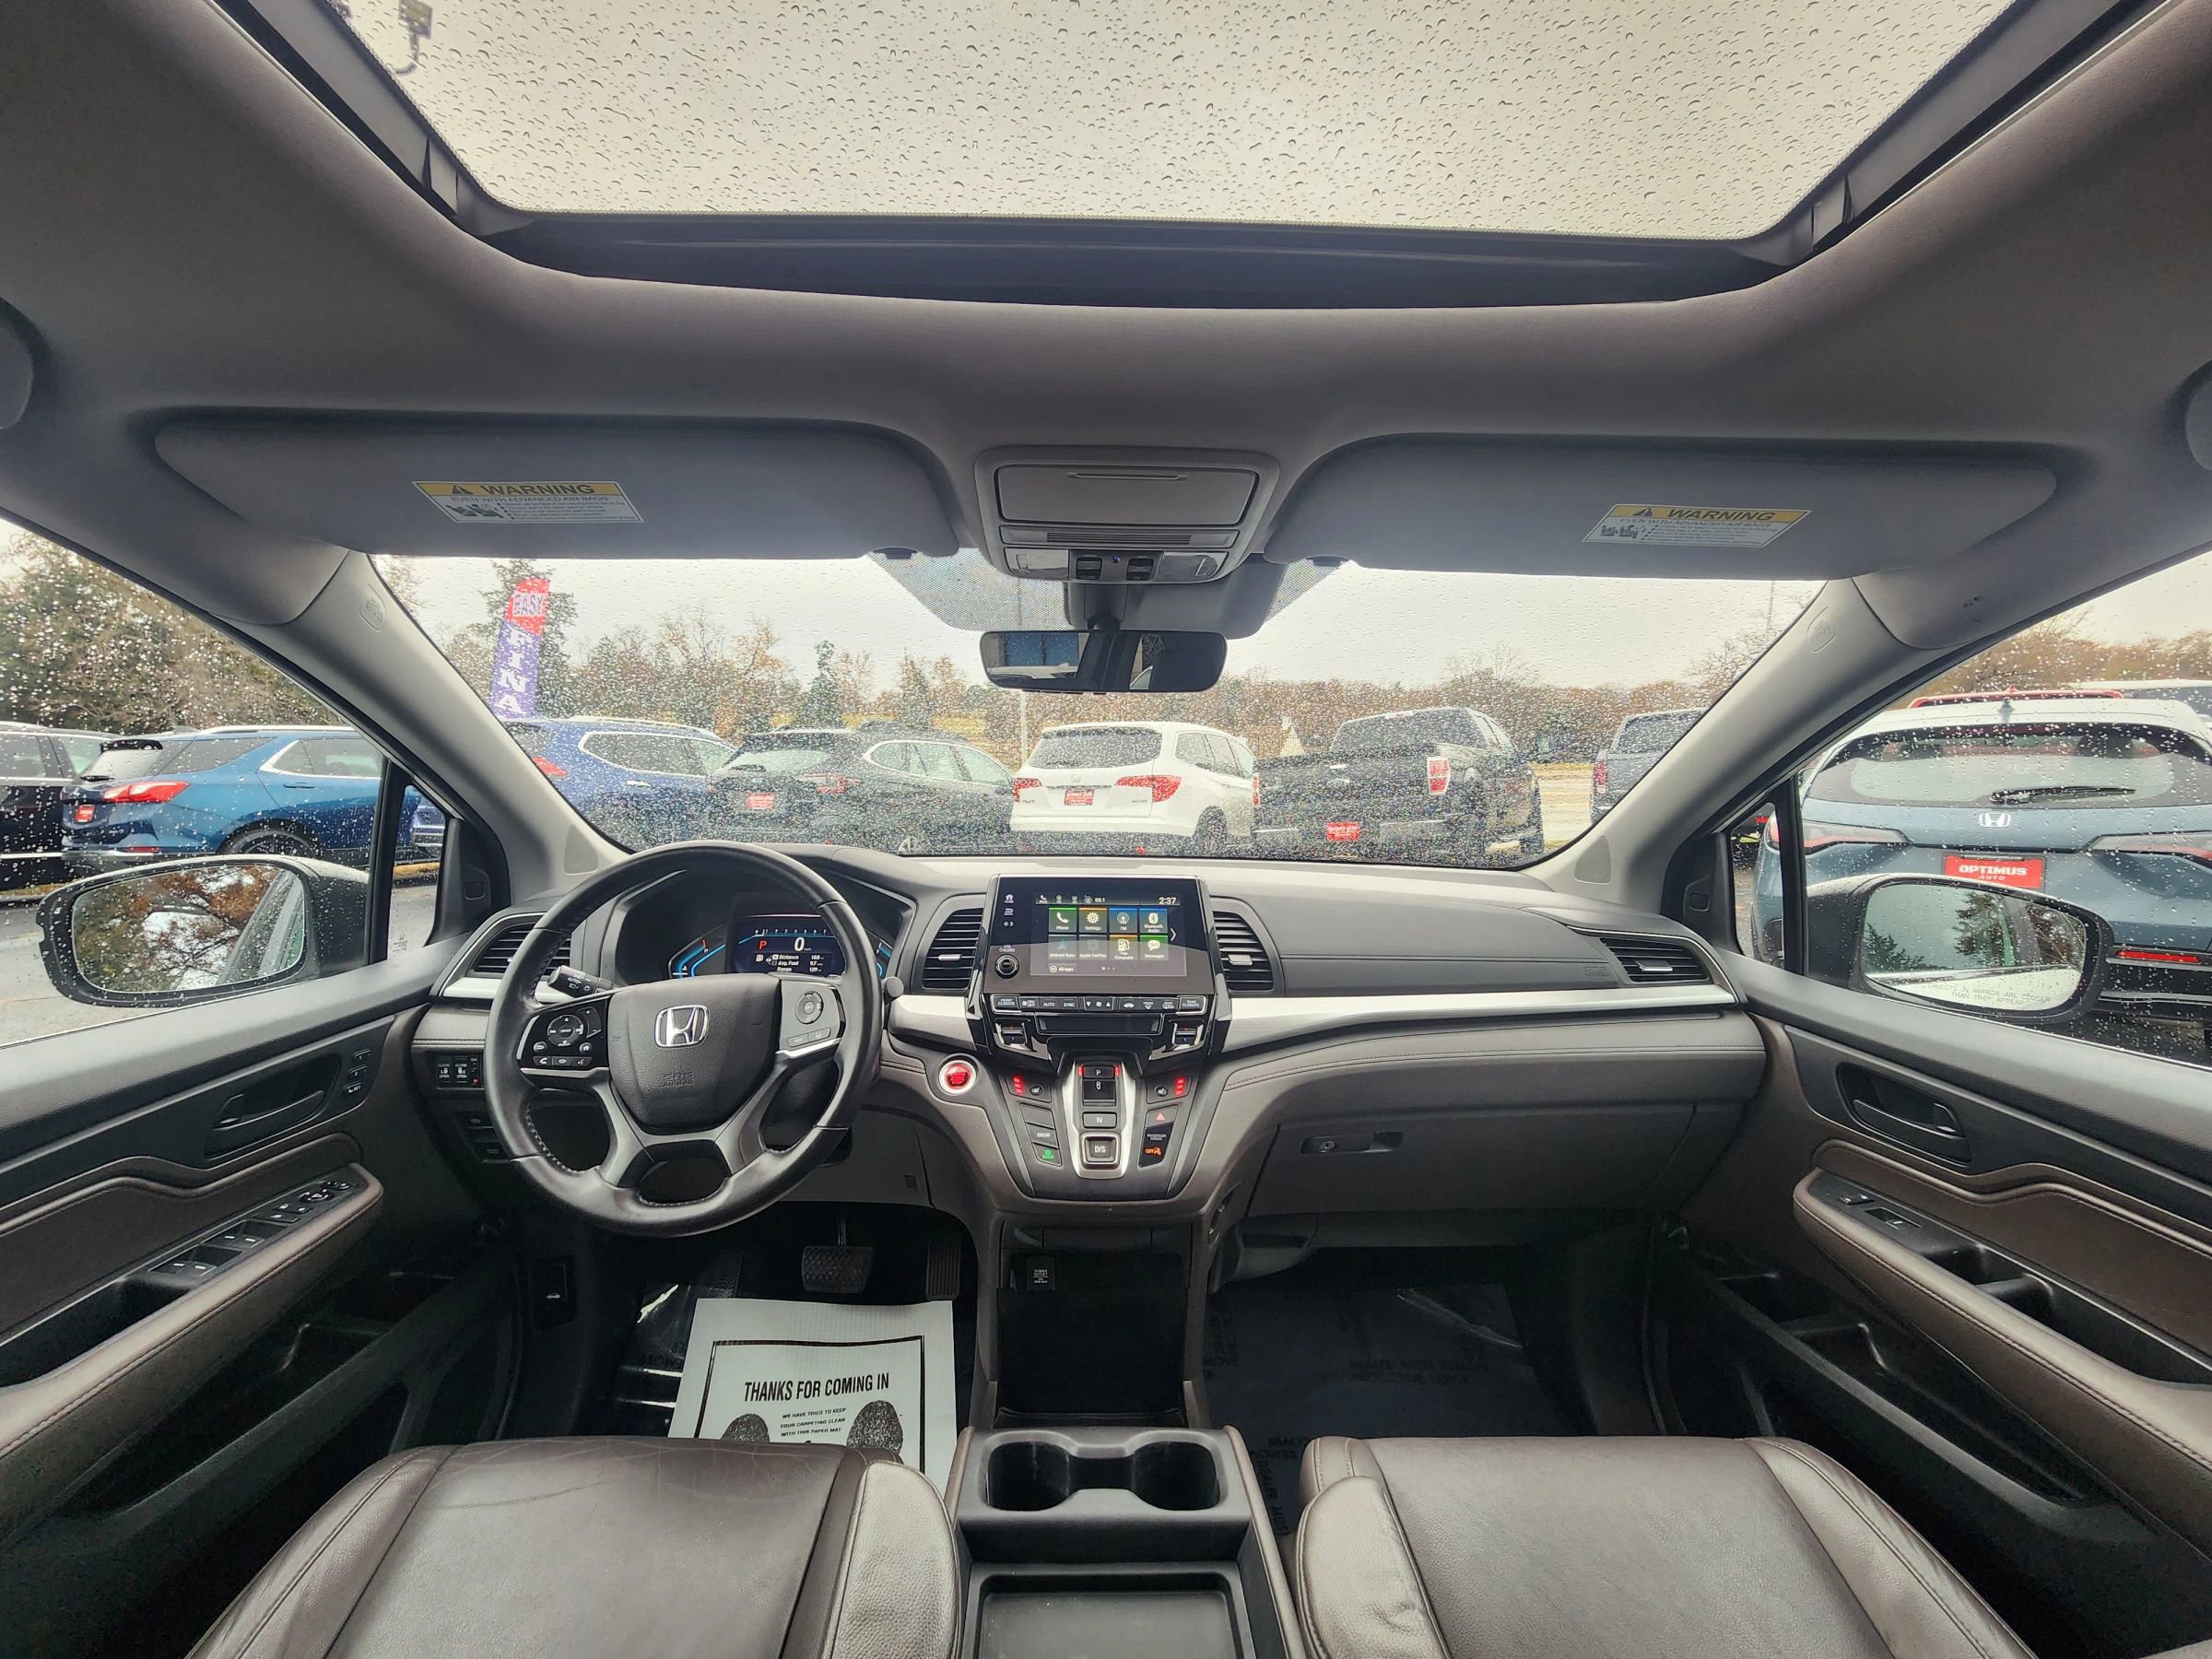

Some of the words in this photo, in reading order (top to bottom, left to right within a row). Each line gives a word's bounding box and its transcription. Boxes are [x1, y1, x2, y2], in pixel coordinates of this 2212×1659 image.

[481, 484, 594, 495] WARNING
[1667, 509, 1775, 521] WARNING
[513, 593, 545, 616] EASY
[1959, 865, 2027, 876] OPTIMUS
[1159, 897, 1177, 905] 2:37
[759, 940, 767, 950] P
[794, 937, 806, 951] 0
[744, 1381, 793, 1402] THANKS
[796, 1381, 820, 1399] FOR
[825, 1374, 873, 1396] COMING
[877, 1372, 889, 1390] IN
